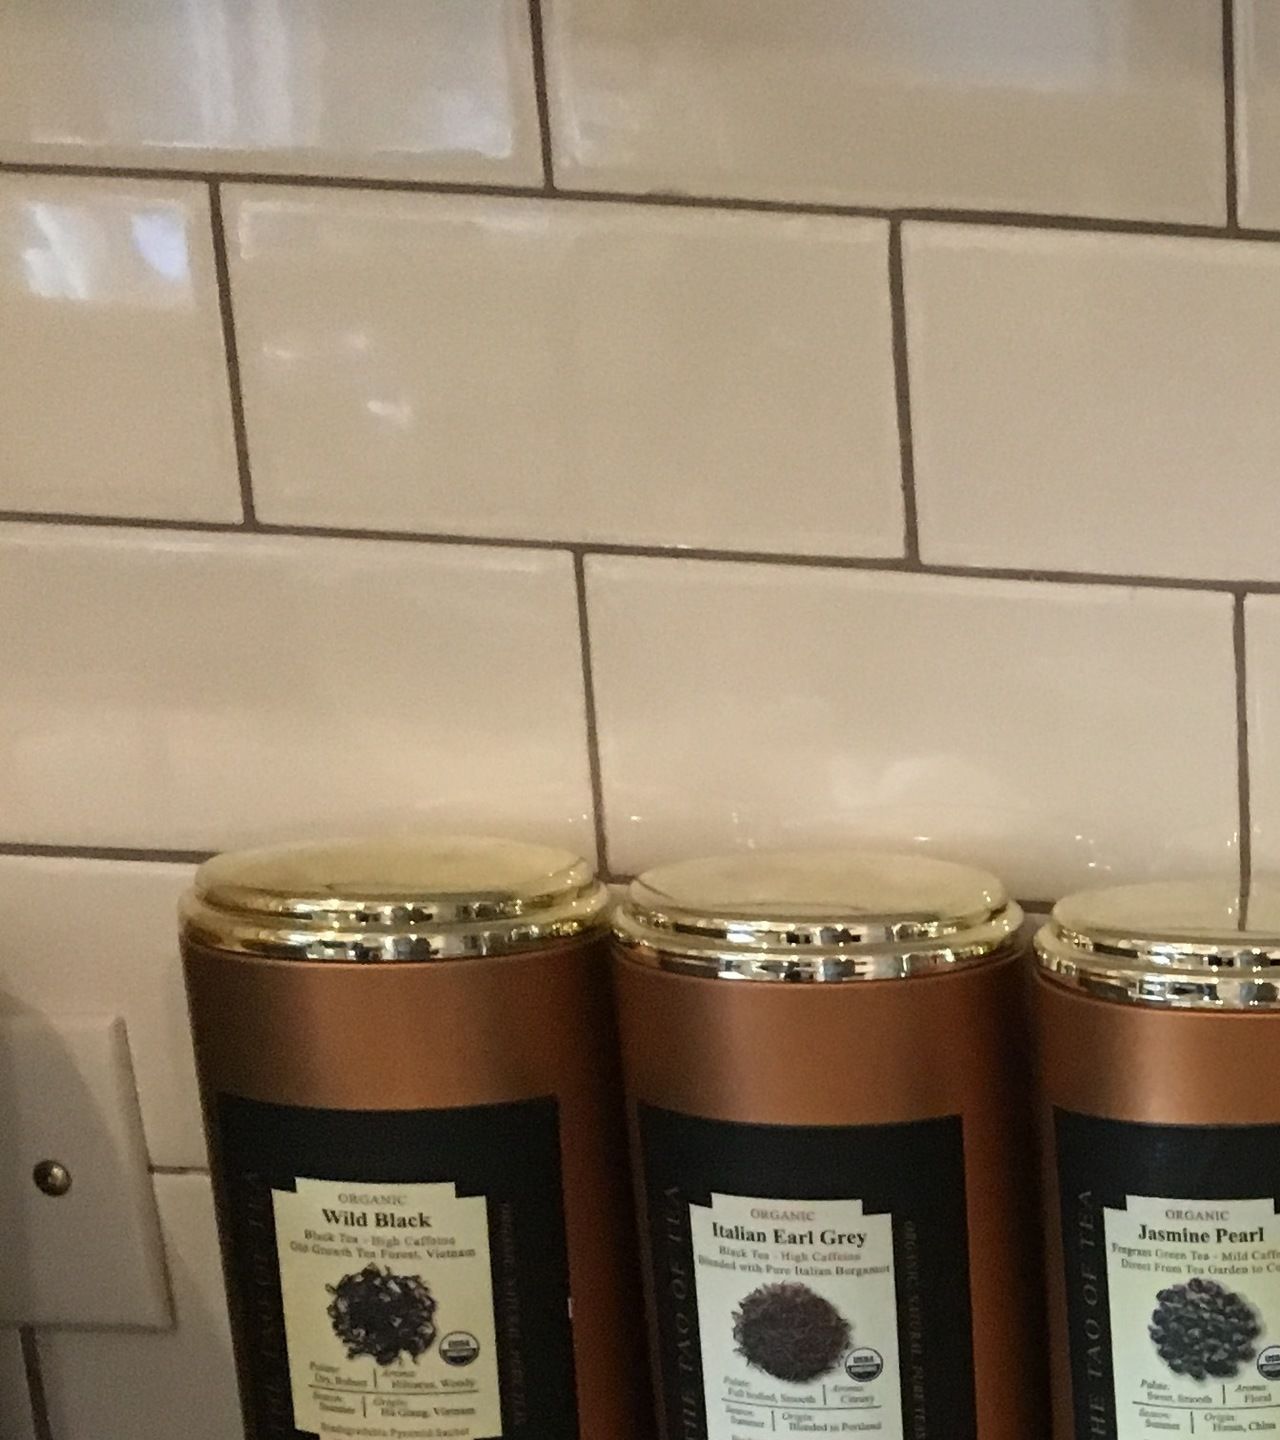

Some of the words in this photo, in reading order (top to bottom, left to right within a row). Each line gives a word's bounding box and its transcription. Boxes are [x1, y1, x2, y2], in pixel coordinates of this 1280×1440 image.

[338, 1193, 407, 1205] ORGANIC
[322, 1209, 367, 1227] Wild
[375, 1212, 432, 1228] Black
[750, 1208, 815, 1221] ORGANIC
[1078, 1189, 1096, 1248] TEA
[1165, 1210, 1230, 1221] ORGANIC
[712, 1222, 766, 1243] Italian
[774, 1230, 813, 1244] Earl
[820, 1230, 867, 1247] Grey
[1138, 1224, 1210, 1243] Jasmine
[1216, 1227, 1264, 1243] Pearl
[719, 1245, 747, 1259] Black
[752, 1249, 769, 1260] Tea
[781, 1251, 808, 1262] High
[812, 1252, 861, 1262] Caffeine
[1155, 1249, 1186, 1260] Green
[1191, 1251, 1209, 1260] Tea
[1222, 1251, 1248, 1261] Mild
[740, 1262, 762, 1273] with
[766, 1264, 790, 1275] Pure
[795, 1265, 831, 1276] Italian
[835, 1265, 890, 1277] Bergamot
[1154, 1263, 1182, 1273] From
[1186, 1264, 1204, 1274] Tea
[1208, 1264, 1248, 1274] Garden
[1252, 1265, 1263, 1273] to
[1081, 1264, 1101, 1305] OF
[1083, 1317, 1104, 1378] TAO
